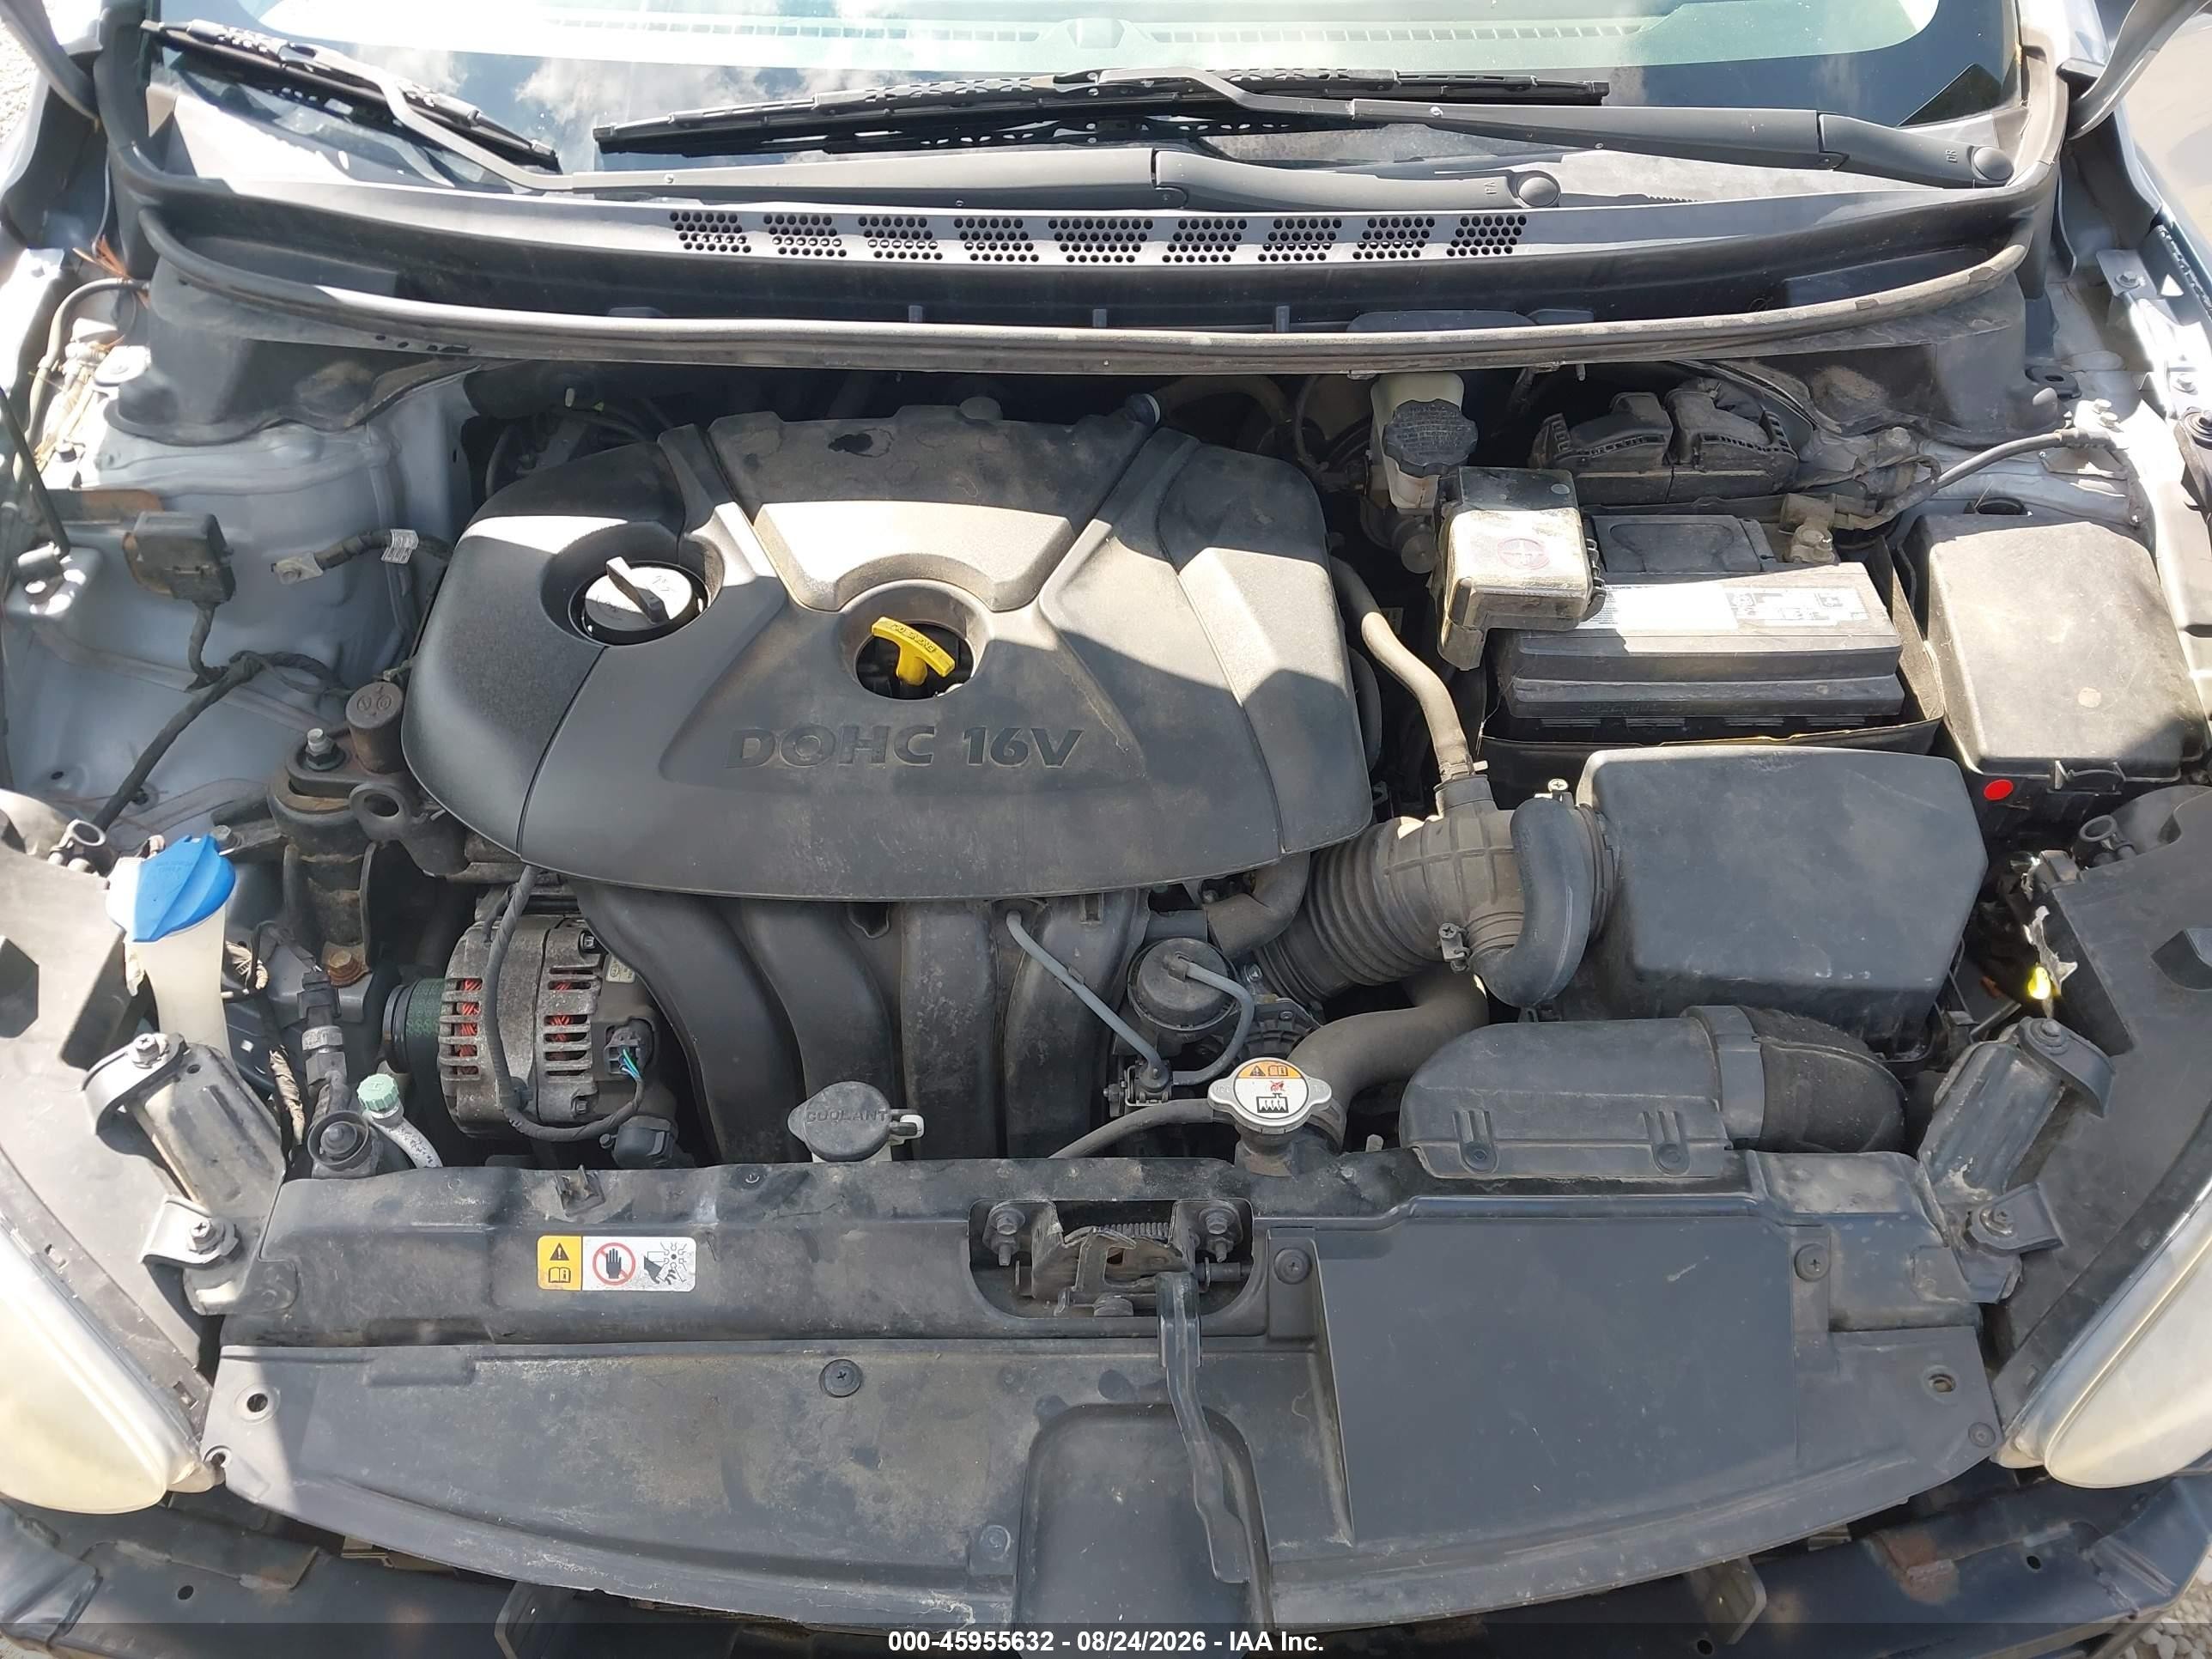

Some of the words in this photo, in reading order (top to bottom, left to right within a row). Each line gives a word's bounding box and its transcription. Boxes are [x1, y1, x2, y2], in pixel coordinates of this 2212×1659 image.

[907, 630, 937, 653] ENGINE
[724, 724, 937, 769] DOHC
[963, 726, 1085, 769] 16V
[806, 1108, 889, 1122] COOLANT
